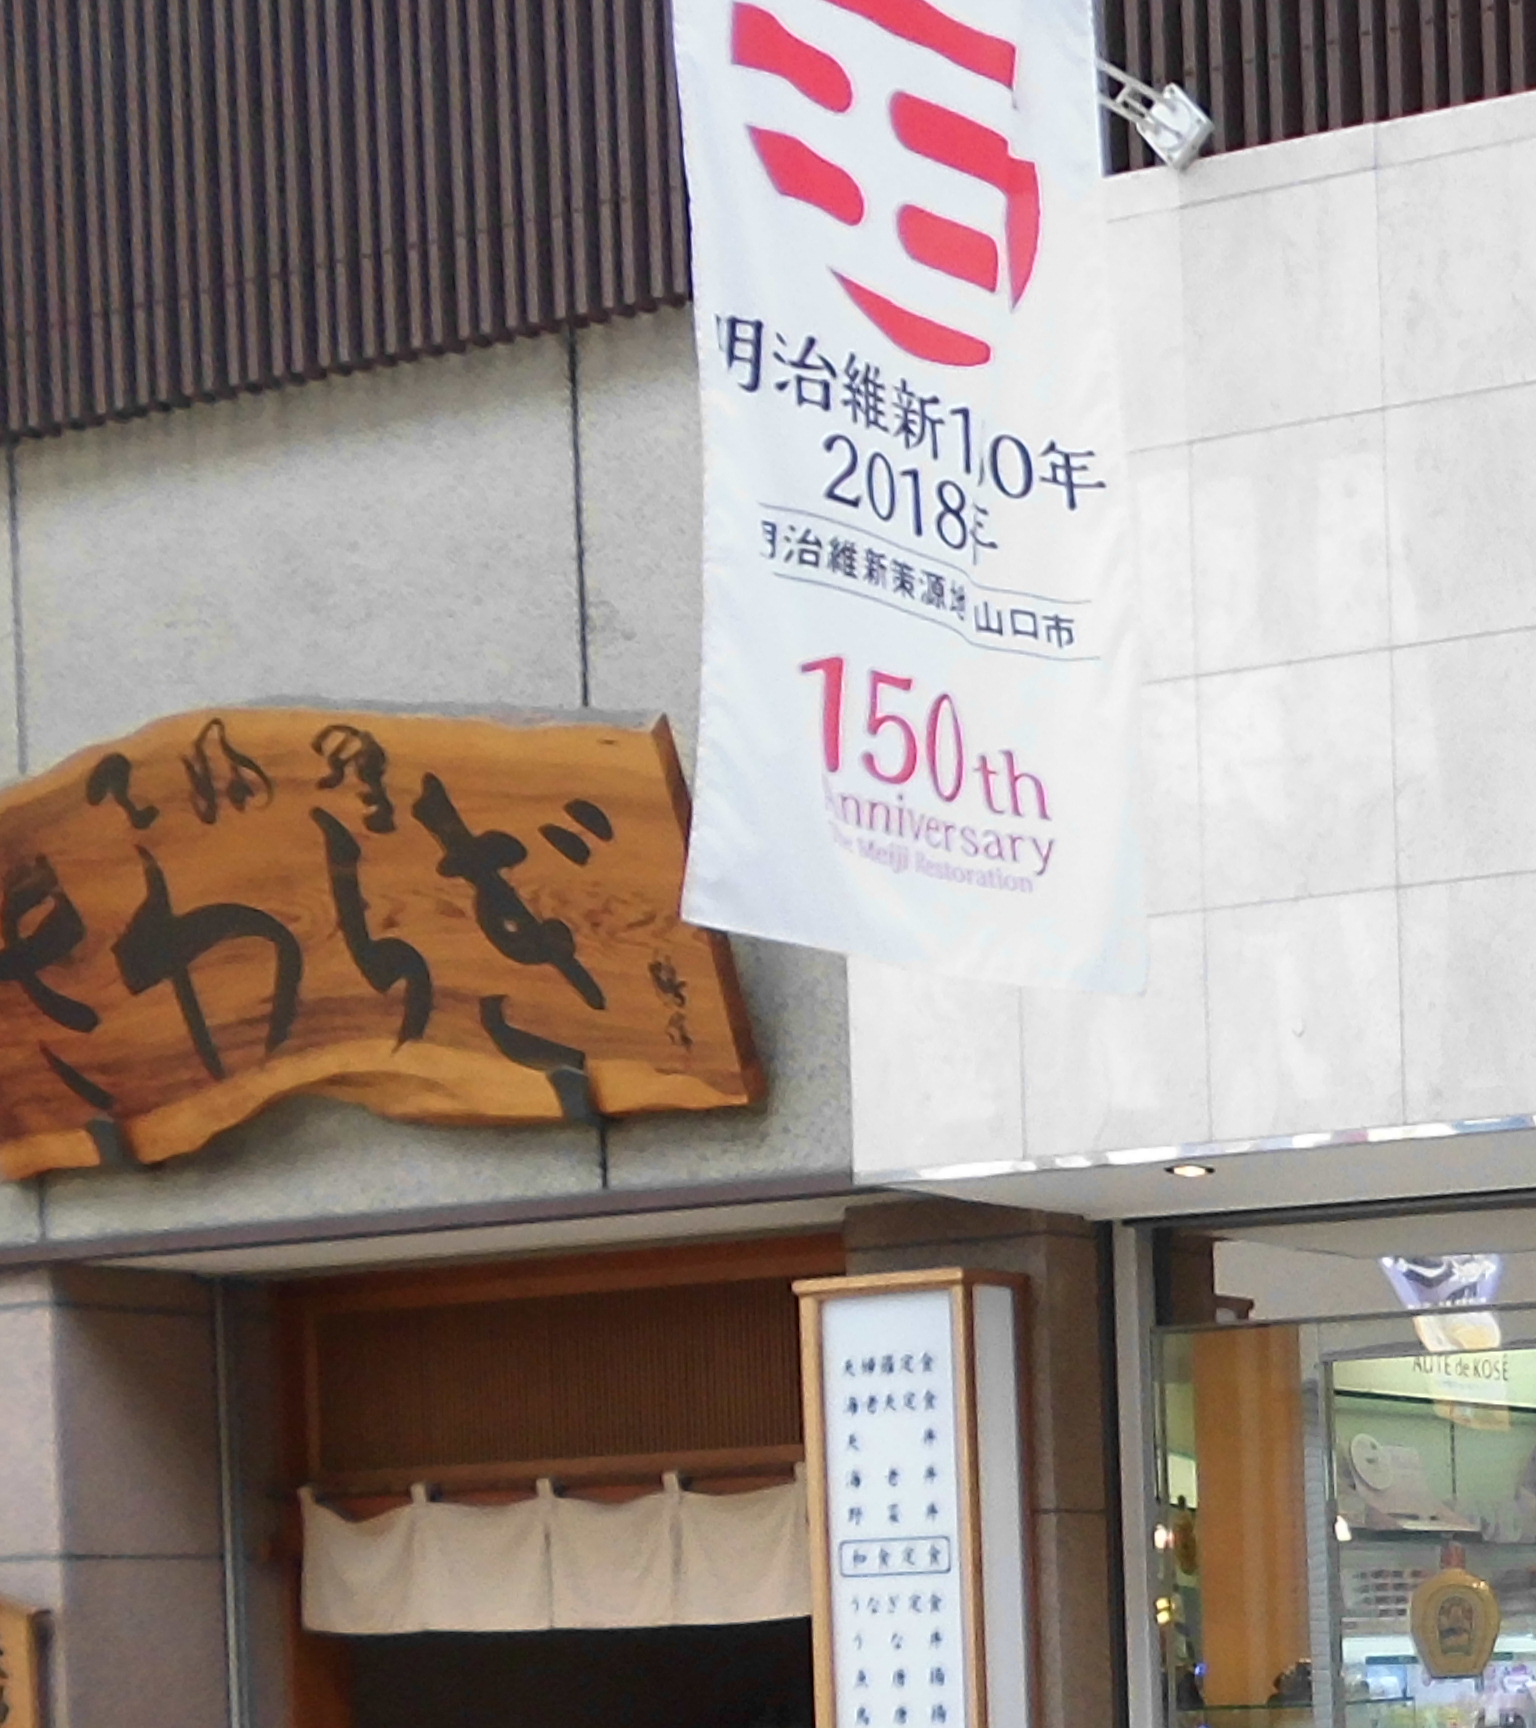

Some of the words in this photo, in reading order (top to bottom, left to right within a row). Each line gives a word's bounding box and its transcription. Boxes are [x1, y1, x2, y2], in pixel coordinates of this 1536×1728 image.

[716, 314, 1106, 511] 明治維新10年
[799, 656, 1053, 821] 150th
